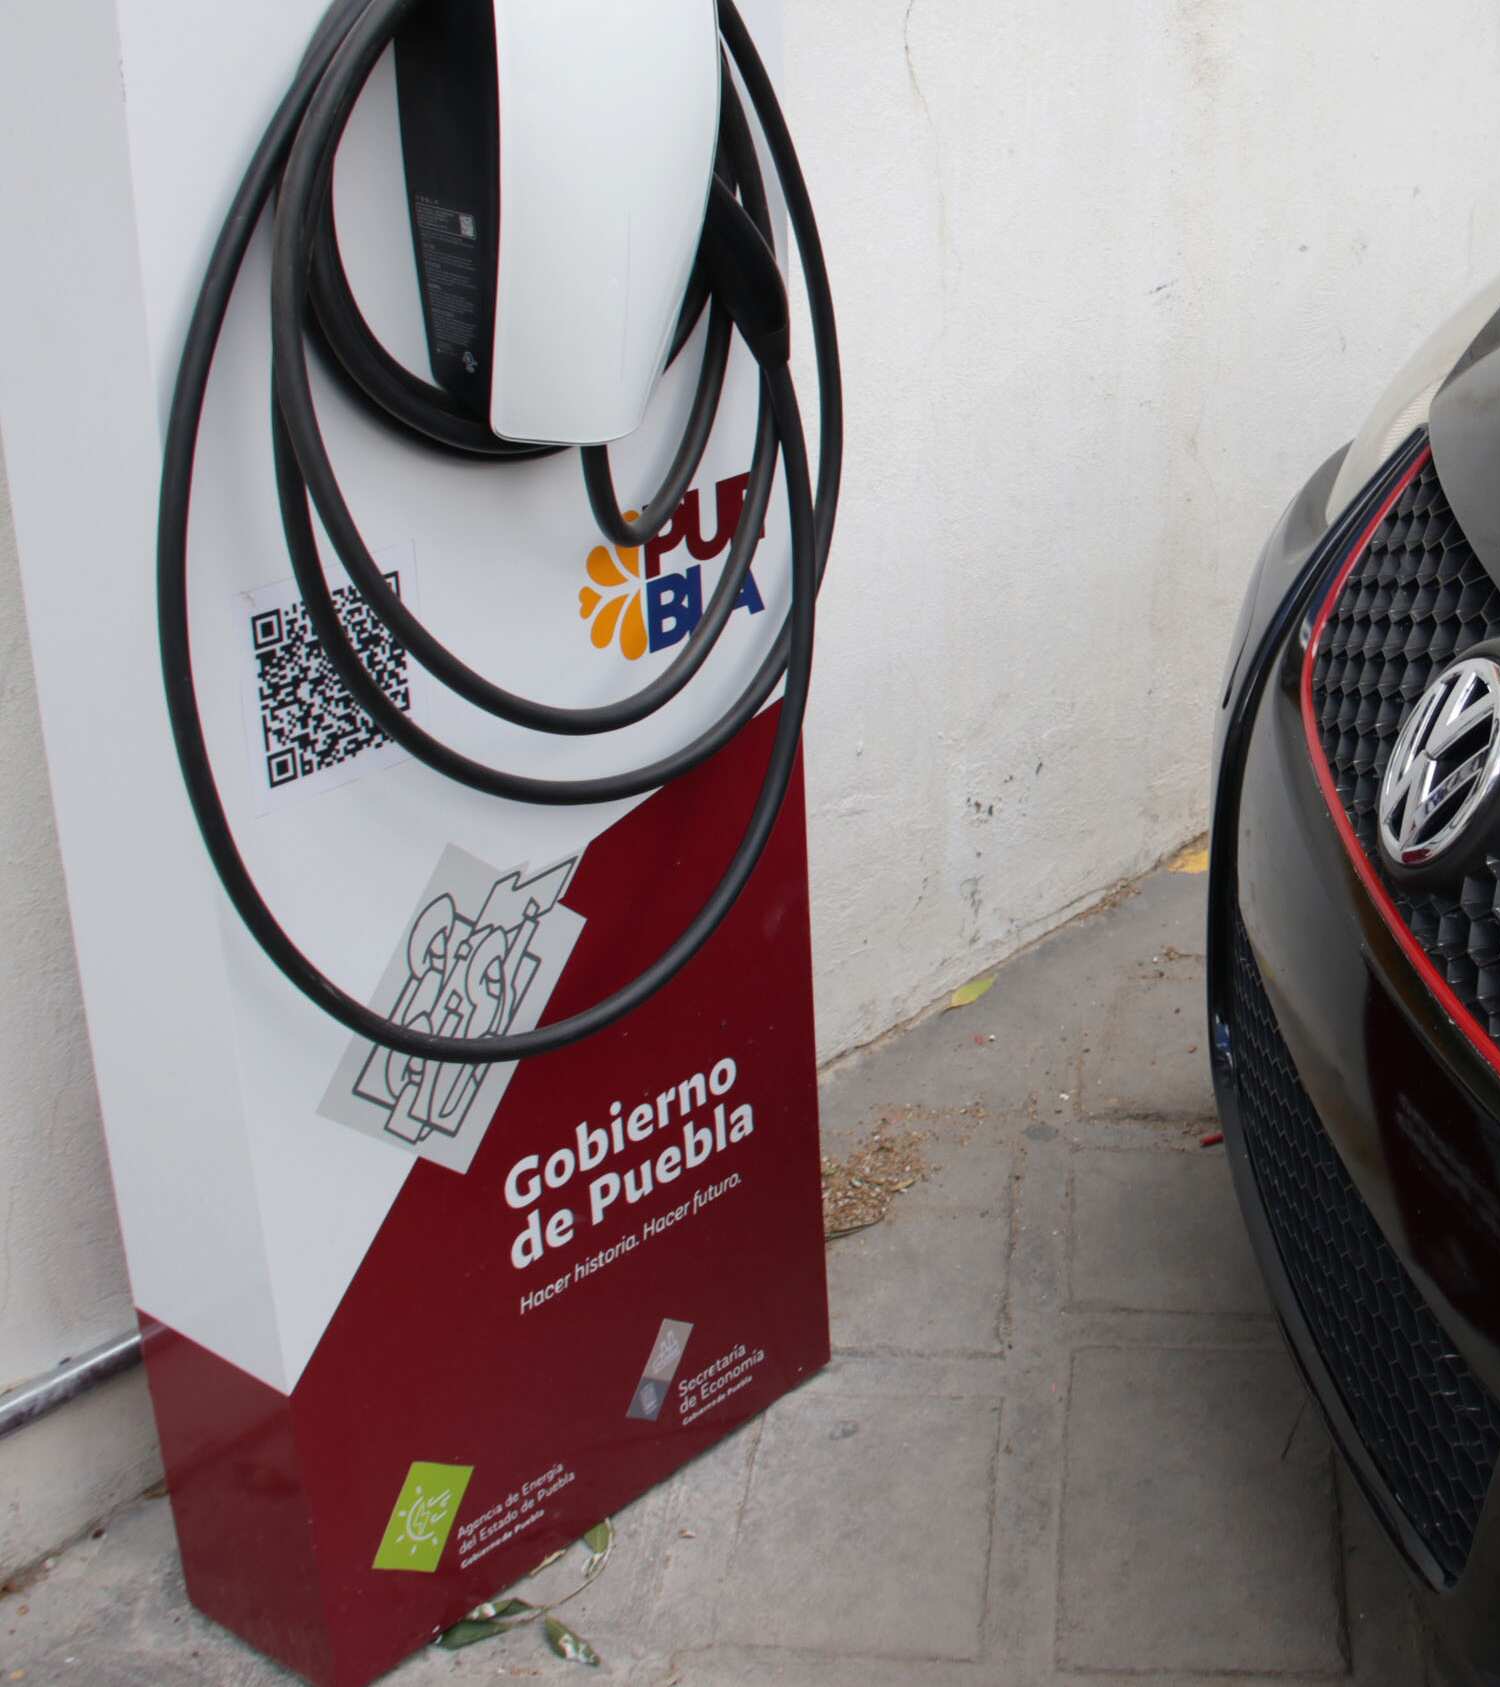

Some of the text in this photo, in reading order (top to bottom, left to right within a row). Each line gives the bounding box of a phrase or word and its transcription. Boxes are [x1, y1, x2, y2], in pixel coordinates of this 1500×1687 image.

[504, 1057, 737, 1209] Gobierno
[510, 1103, 754, 1270] de Puebla
[520, 1171, 742, 1315] Hacer historia. Hacer futuro.
[679, 1344, 747, 1397] Secretaría
[680, 1395, 697, 1414] de
[700, 1349, 765, 1400] Economía
[457, 1503, 503, 1540] Agencia
[505, 1493, 520, 1508] de
[459, 1535, 477, 1555] del
[479, 1510, 518, 1541] Estado
[521, 1498, 535, 1513] de
[537, 1471, 576, 1501] Puebla
